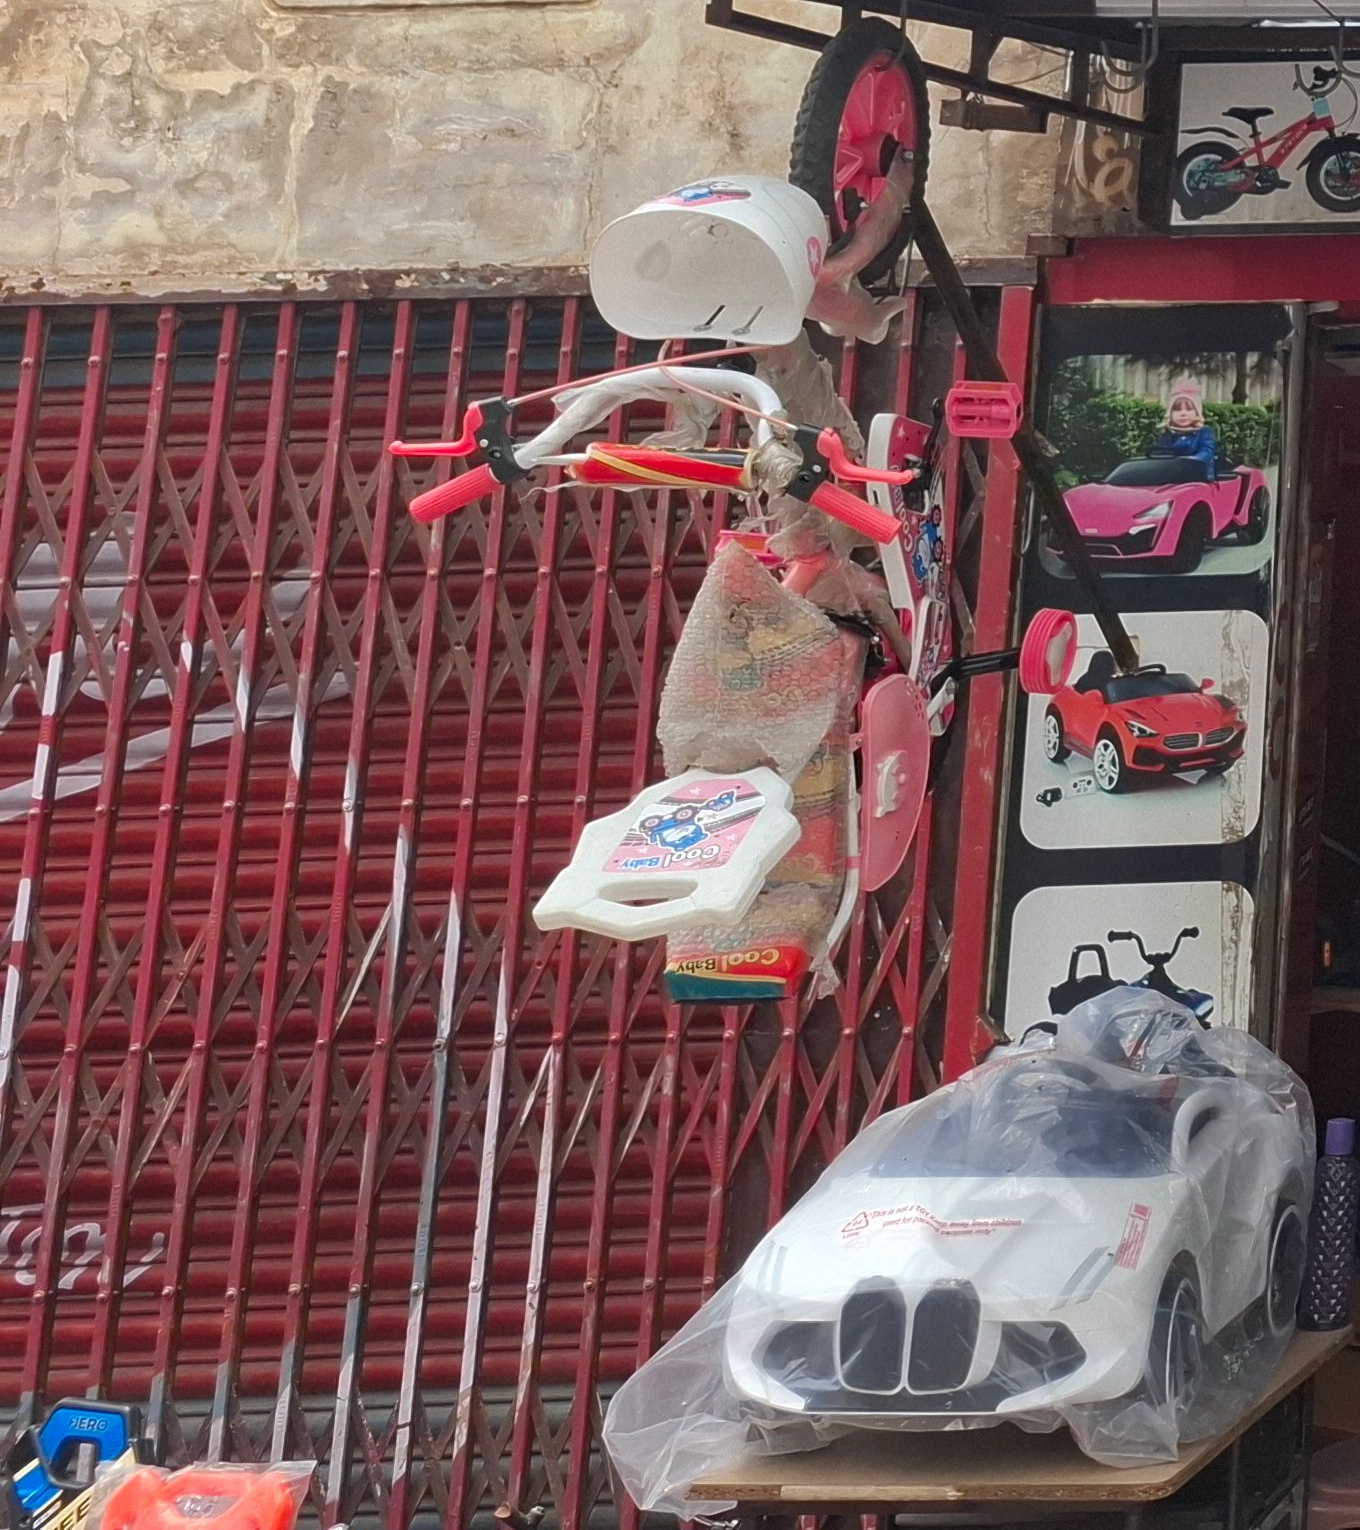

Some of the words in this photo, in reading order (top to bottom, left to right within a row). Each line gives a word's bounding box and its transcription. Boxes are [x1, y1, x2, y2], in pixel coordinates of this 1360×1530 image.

[618, 856, 660, 870] Baby
[661, 844, 721, 869] Cool
[675, 958, 717, 974] Baby
[720, 948, 781, 972] Cool
[68, 1414, 109, 1432] HERO
